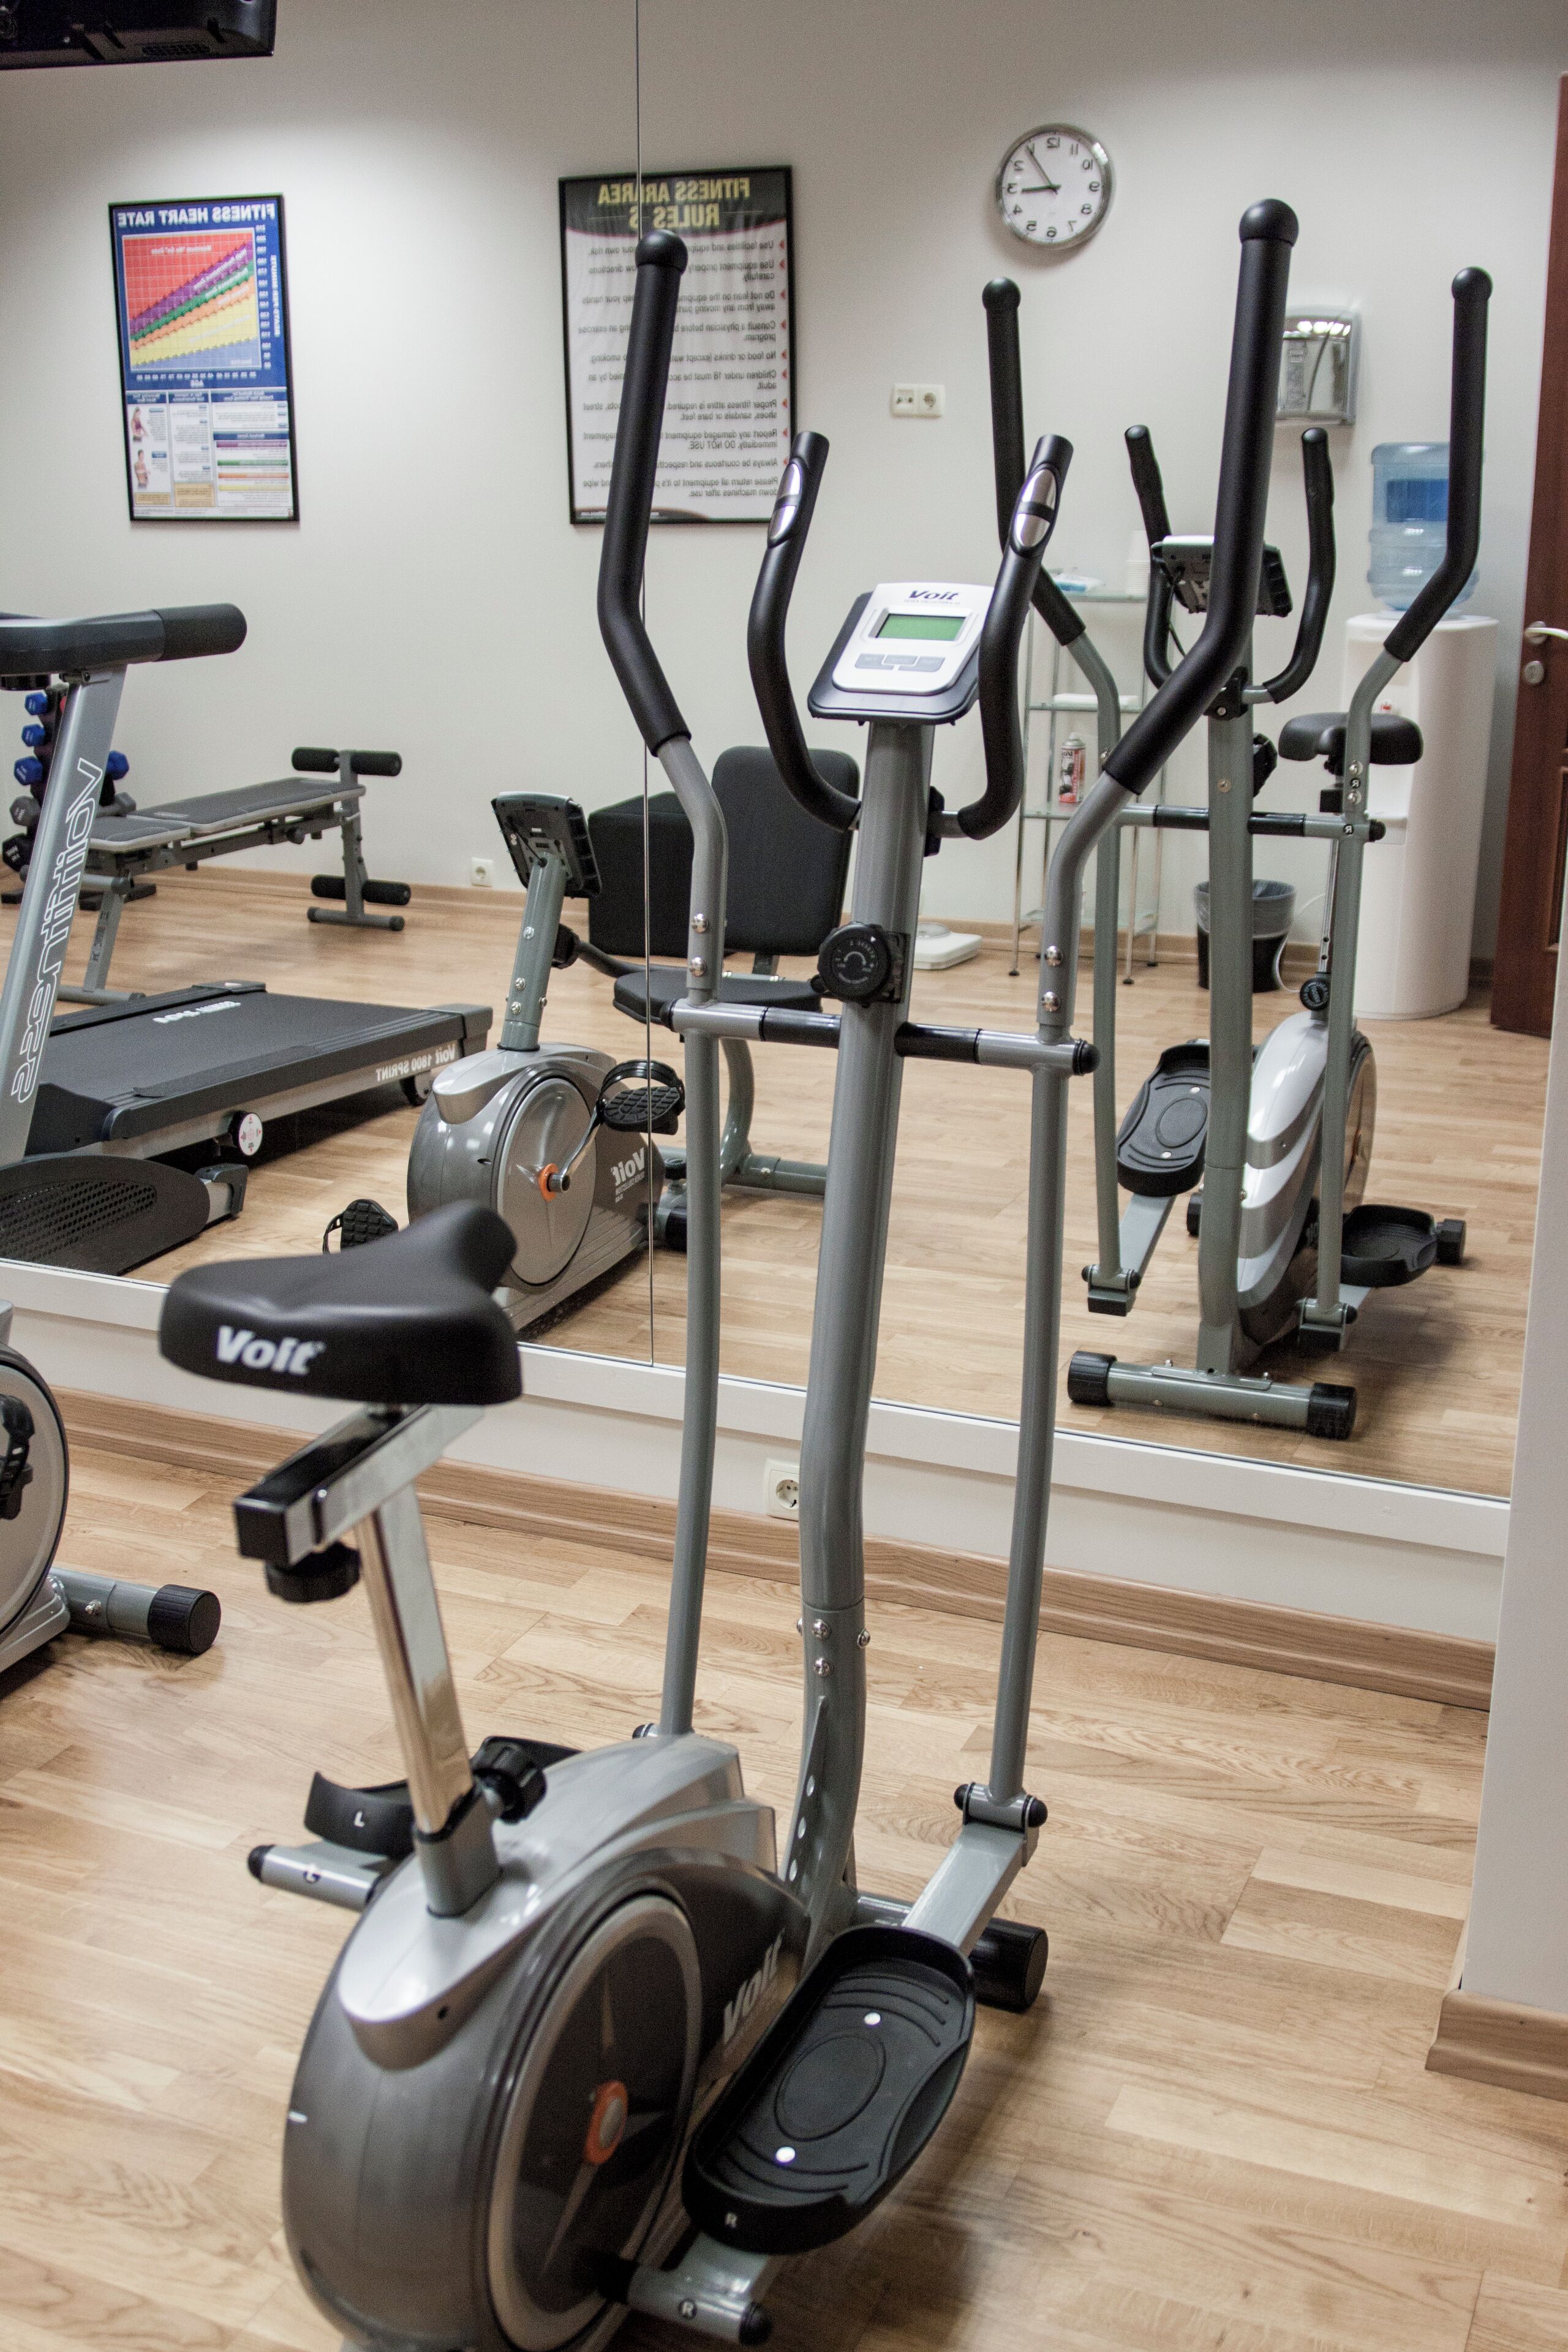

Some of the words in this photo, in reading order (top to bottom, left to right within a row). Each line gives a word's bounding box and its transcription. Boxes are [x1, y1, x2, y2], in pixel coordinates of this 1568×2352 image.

[909, 590, 959, 600] Voit
[217, 1324, 315, 1376] Voit
[354, 1810, 366, 1828] L
[725, 2211, 737, 2229] R
[682, 2301, 694, 2316] R
